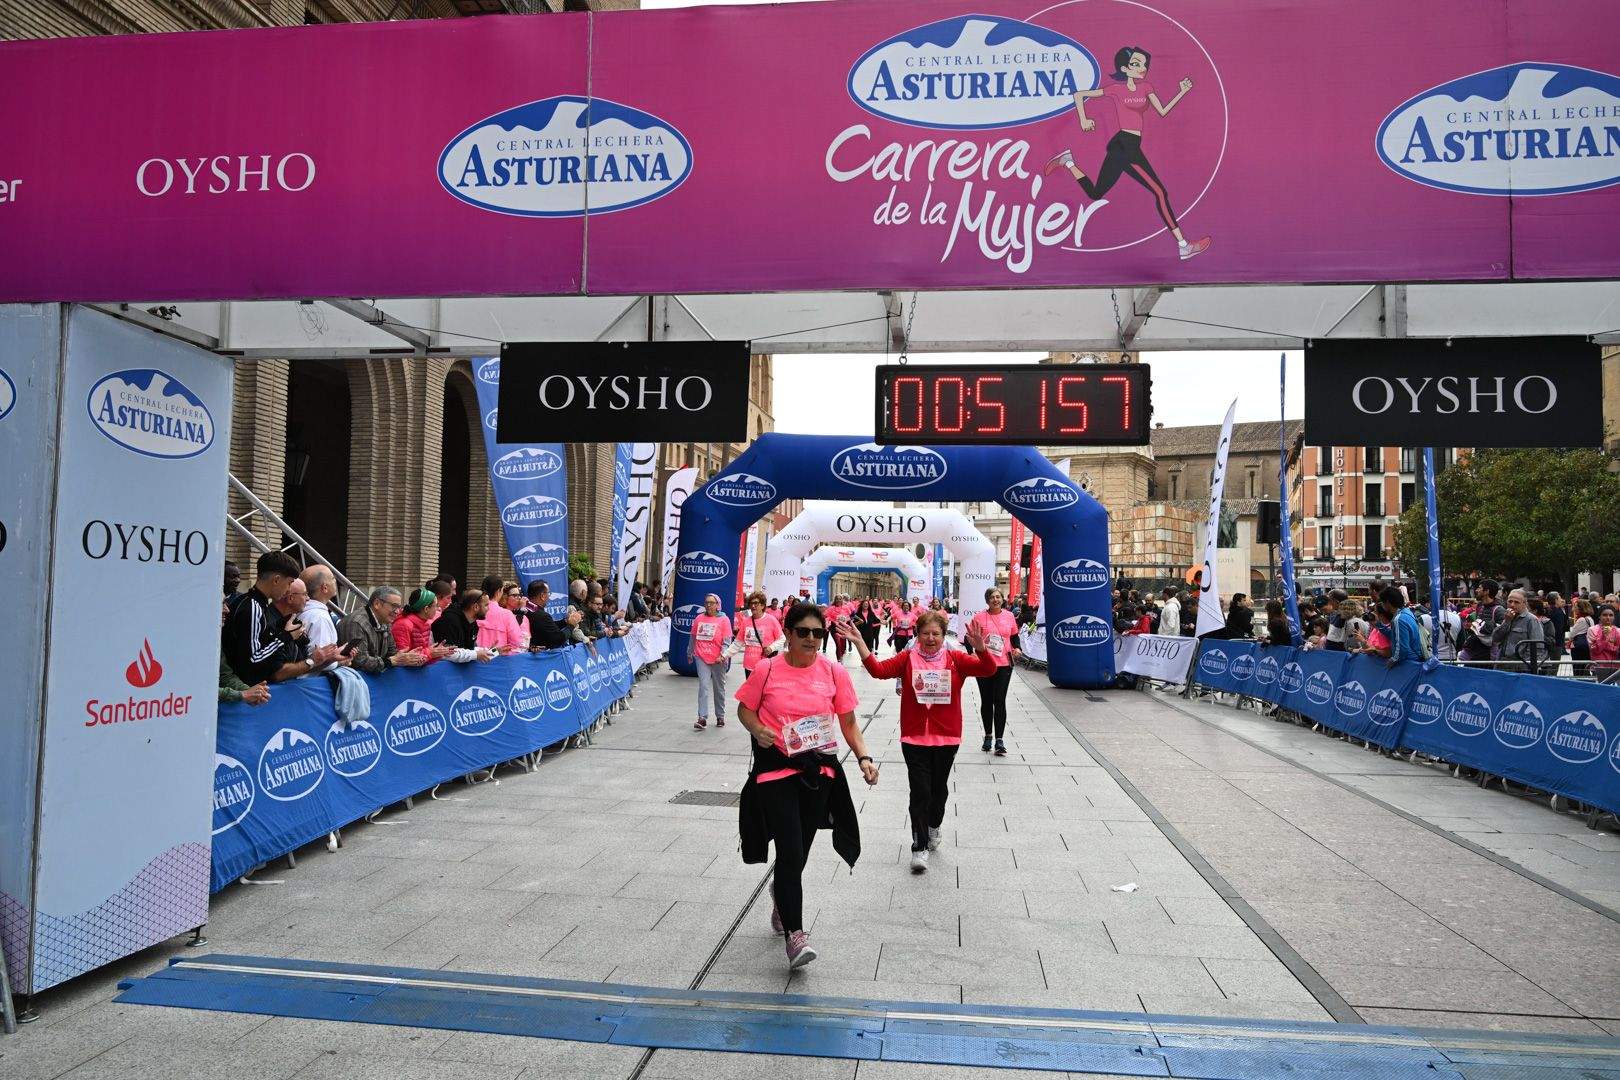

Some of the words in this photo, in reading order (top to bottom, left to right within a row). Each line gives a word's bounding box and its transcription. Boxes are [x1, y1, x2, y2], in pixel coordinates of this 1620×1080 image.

[905, 55, 983, 67] CENTRAL
[992, 52, 1073, 65] LECHERA
[866, 60, 1079, 101] ASTURIANA
[1446, 109, 1541, 124] CENTRAL
[496, 137, 575, 151] CENTRAL
[583, 133, 665, 149] LECHERA
[136, 152, 316, 197] OYSHO
[456, 143, 673, 188] ASTURIANA
[873, 185, 912, 226] de
[920, 186, 947, 226] la
[941, 174, 1110, 274] Mujer
[120, 391, 161, 411] CENTRAL
[164, 402, 204, 421] LECHERA
[539, 374, 713, 411] OYSHO
[1352, 375, 1558, 415] OYSHO
[97, 389, 207, 446] ASTURIANA
[839, 456, 938, 478] ASTURIANA
[1336, 449, 1344, 497] HOTEL
[710, 484, 771, 499] ASTURIANA
[1010, 490, 1074, 503] ASTURIANA
[836, 515, 927, 534] OYSHO
[82, 519, 209, 566] OYSHO
[679, 561, 725, 575] ASTURIANA
[1055, 570, 1107, 583] ASTURIANA
[1056, 626, 1109, 639] ASTURIANA
[1136, 638, 1181, 660] OYSHO
[85, 693, 192, 728] Santander
[455, 705, 503, 728] ASTURIANA
[1447, 707, 1487, 728] ASTURIANA
[390, 719, 444, 747] ASTURIANA
[1496, 717, 1539, 740] ASTURIANA
[1550, 725, 1601, 754] ASTURIANA
[330, 738, 379, 766] ASTURIANA
[264, 754, 323, 791] ASTURIANA
